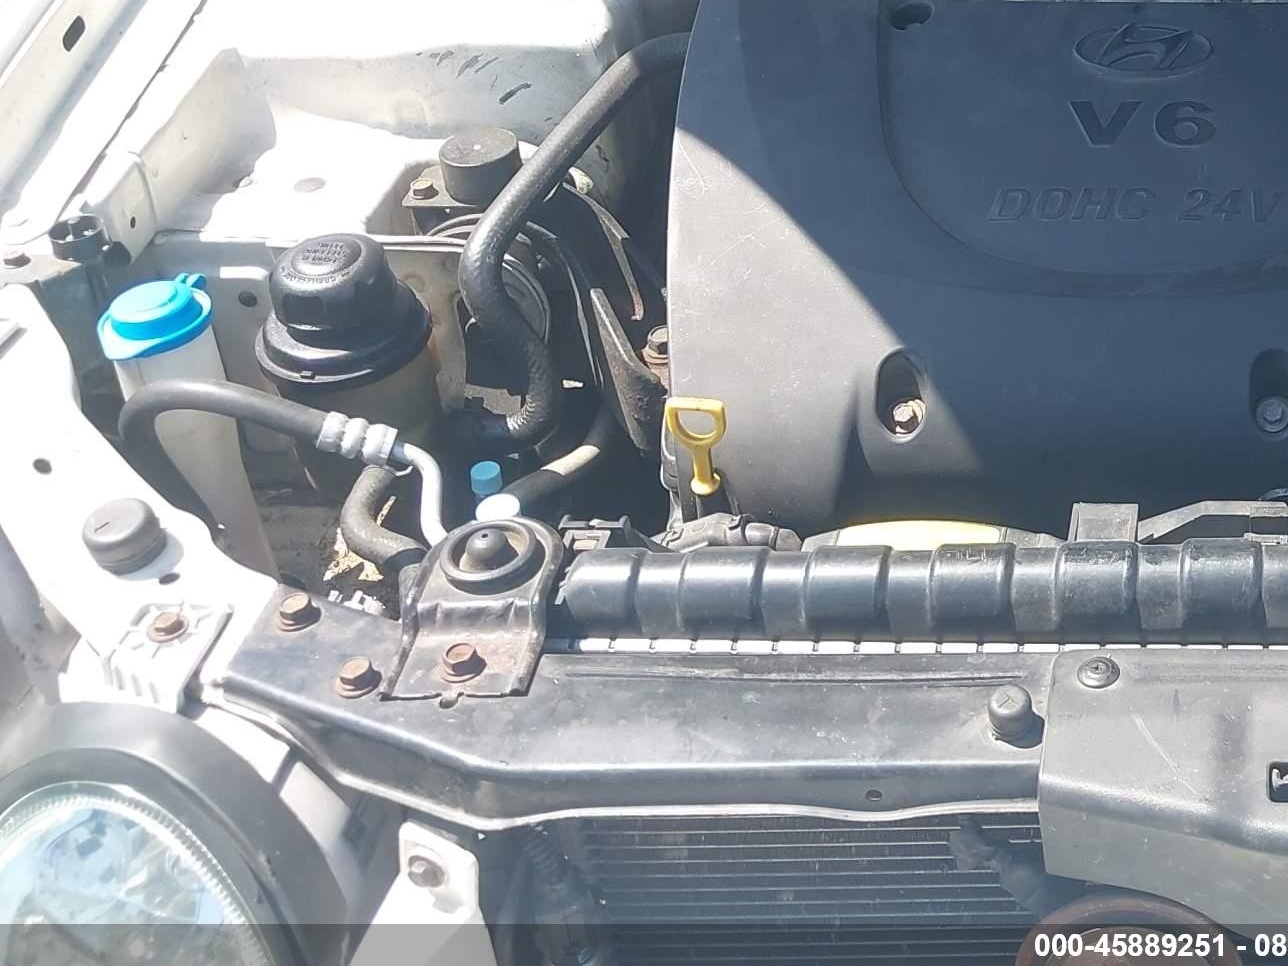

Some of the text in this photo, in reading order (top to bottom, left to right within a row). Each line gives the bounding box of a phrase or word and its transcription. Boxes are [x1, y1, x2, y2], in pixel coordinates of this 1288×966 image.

[1067, 98, 1218, 149] V6
[985, 186, 1284, 223] DOHC 24V
